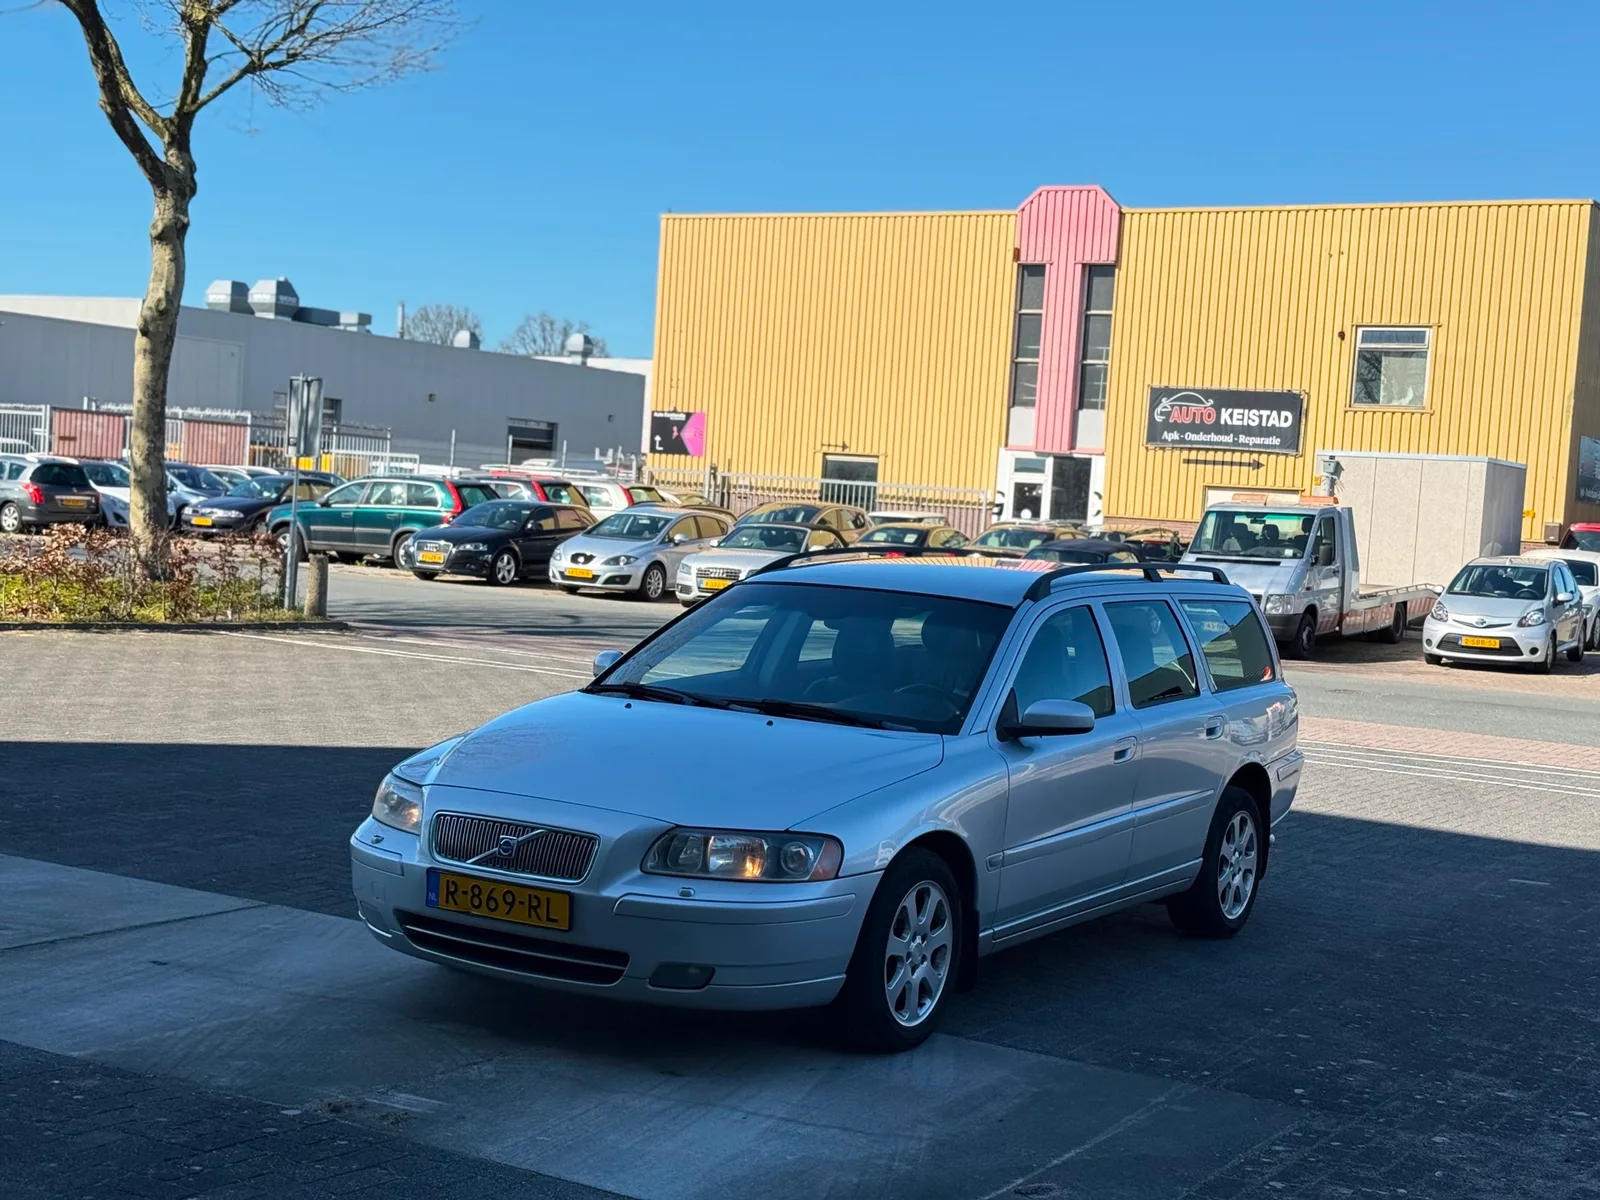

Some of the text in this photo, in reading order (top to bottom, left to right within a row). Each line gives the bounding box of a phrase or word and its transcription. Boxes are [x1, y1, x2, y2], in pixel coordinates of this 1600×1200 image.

[1169, 406, 1293, 427] AUTO KEISTAD
[1162, 430, 1180, 442] Apk
[1184, 431, 1233, 442] Onderhoud
[1239, 434, 1281, 445] Reparatie
[428, 891, 437, 901] NL
[445, 879, 559, 923] R-869-RL
